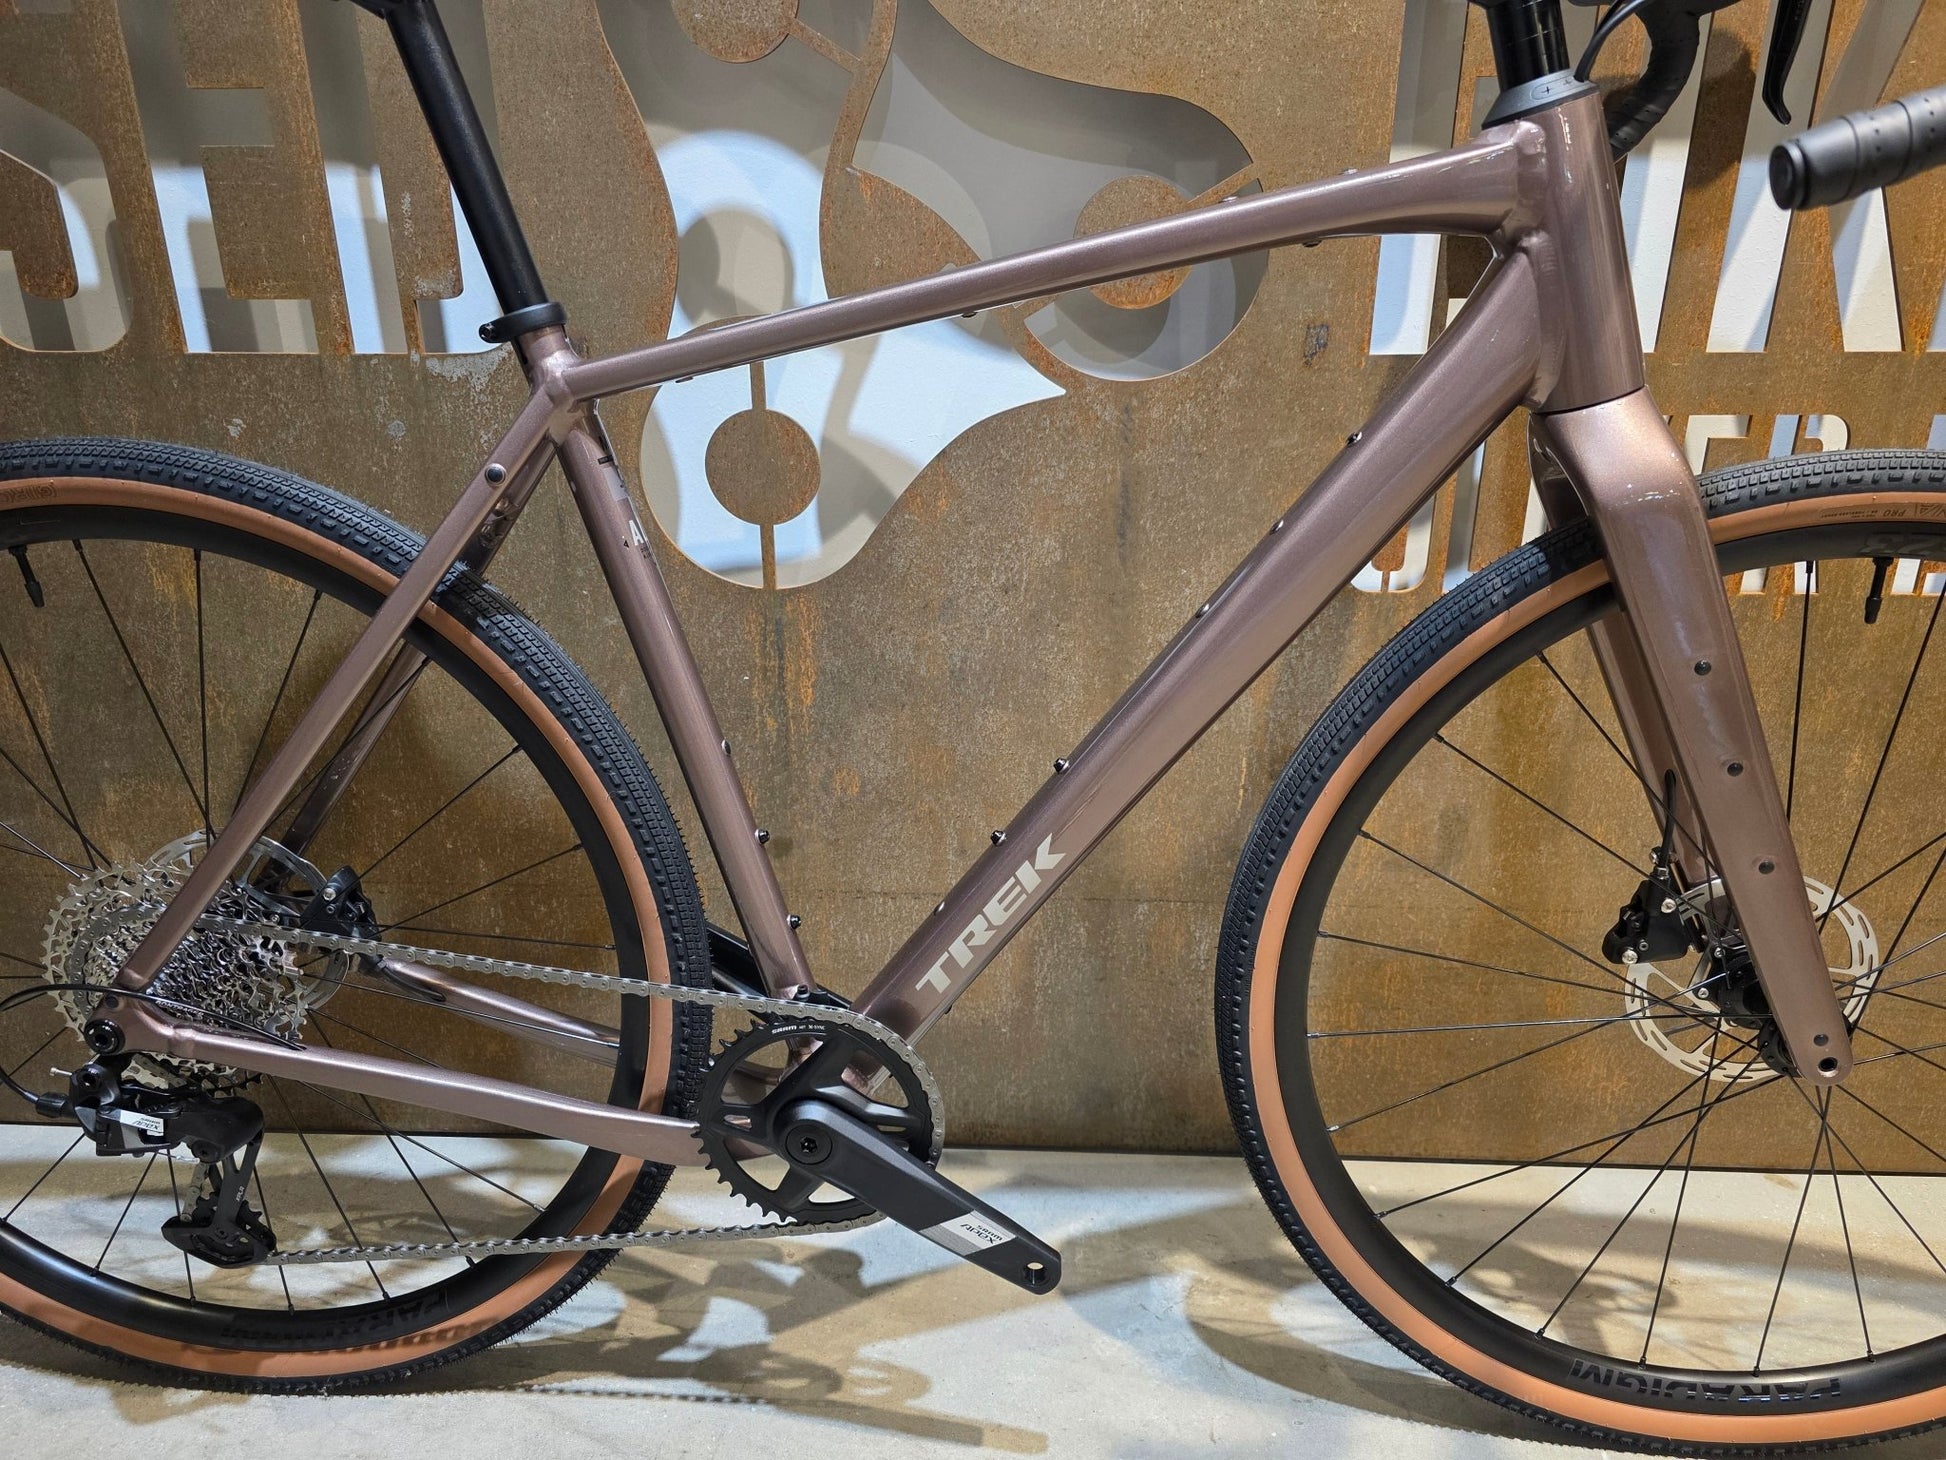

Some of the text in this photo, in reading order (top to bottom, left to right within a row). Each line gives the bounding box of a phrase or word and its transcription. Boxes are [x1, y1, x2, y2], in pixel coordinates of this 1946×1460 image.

[1882, 509, 1907, 518] PRO
[915, 833, 1066, 994] TREK
[977, 1226, 1003, 1241] SRAM
[1568, 1359, 1841, 1403] PARADIGM
